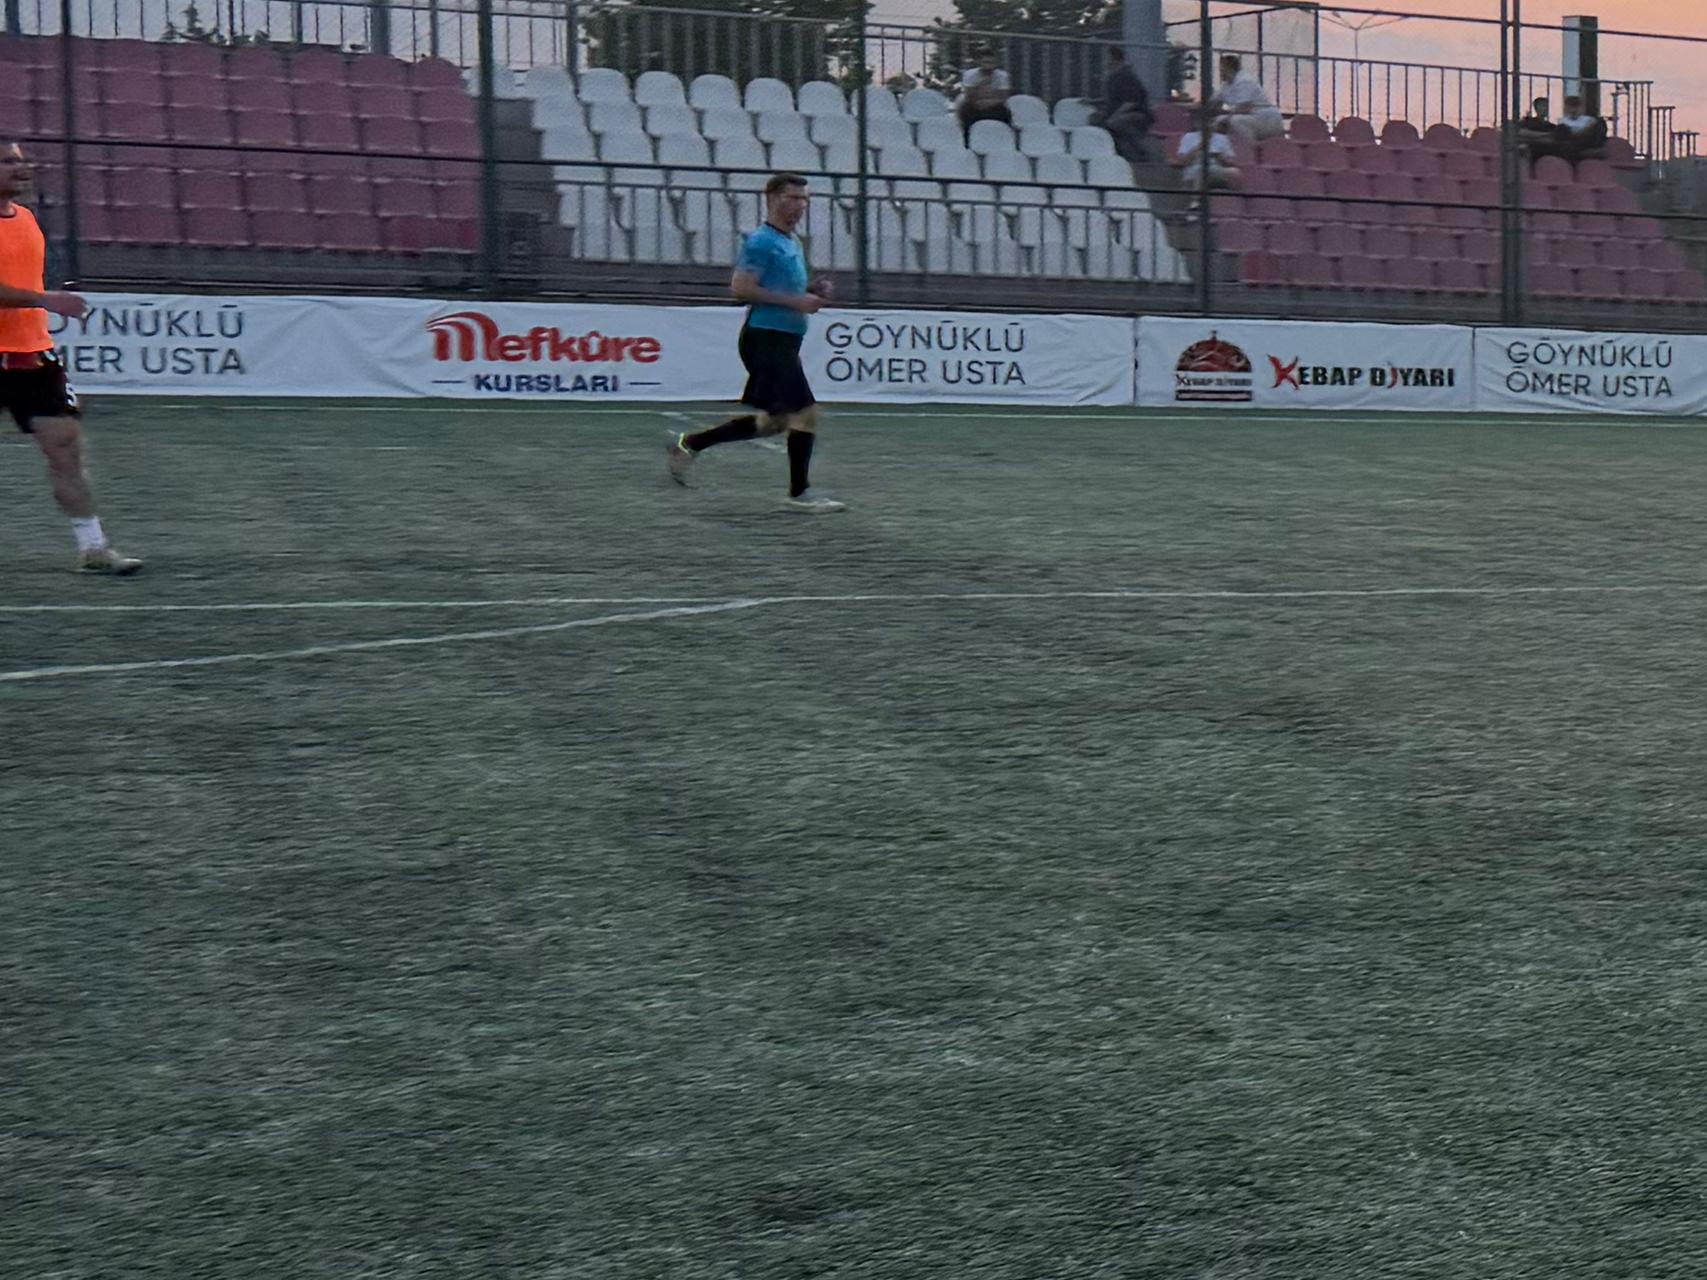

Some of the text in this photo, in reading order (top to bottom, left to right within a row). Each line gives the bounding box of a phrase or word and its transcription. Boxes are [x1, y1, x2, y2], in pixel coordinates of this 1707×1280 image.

[825, 318, 1025, 353] GÖYNÜKLÜ
[140, 346, 246, 375] USTA
[826, 351, 1026, 386] ÖMER USTA
[1506, 337, 1673, 369] GÖYNÜKLÜ
[473, 373, 620, 393] KURSLARI
[1506, 365, 1673, 398] ÖMER USTA
